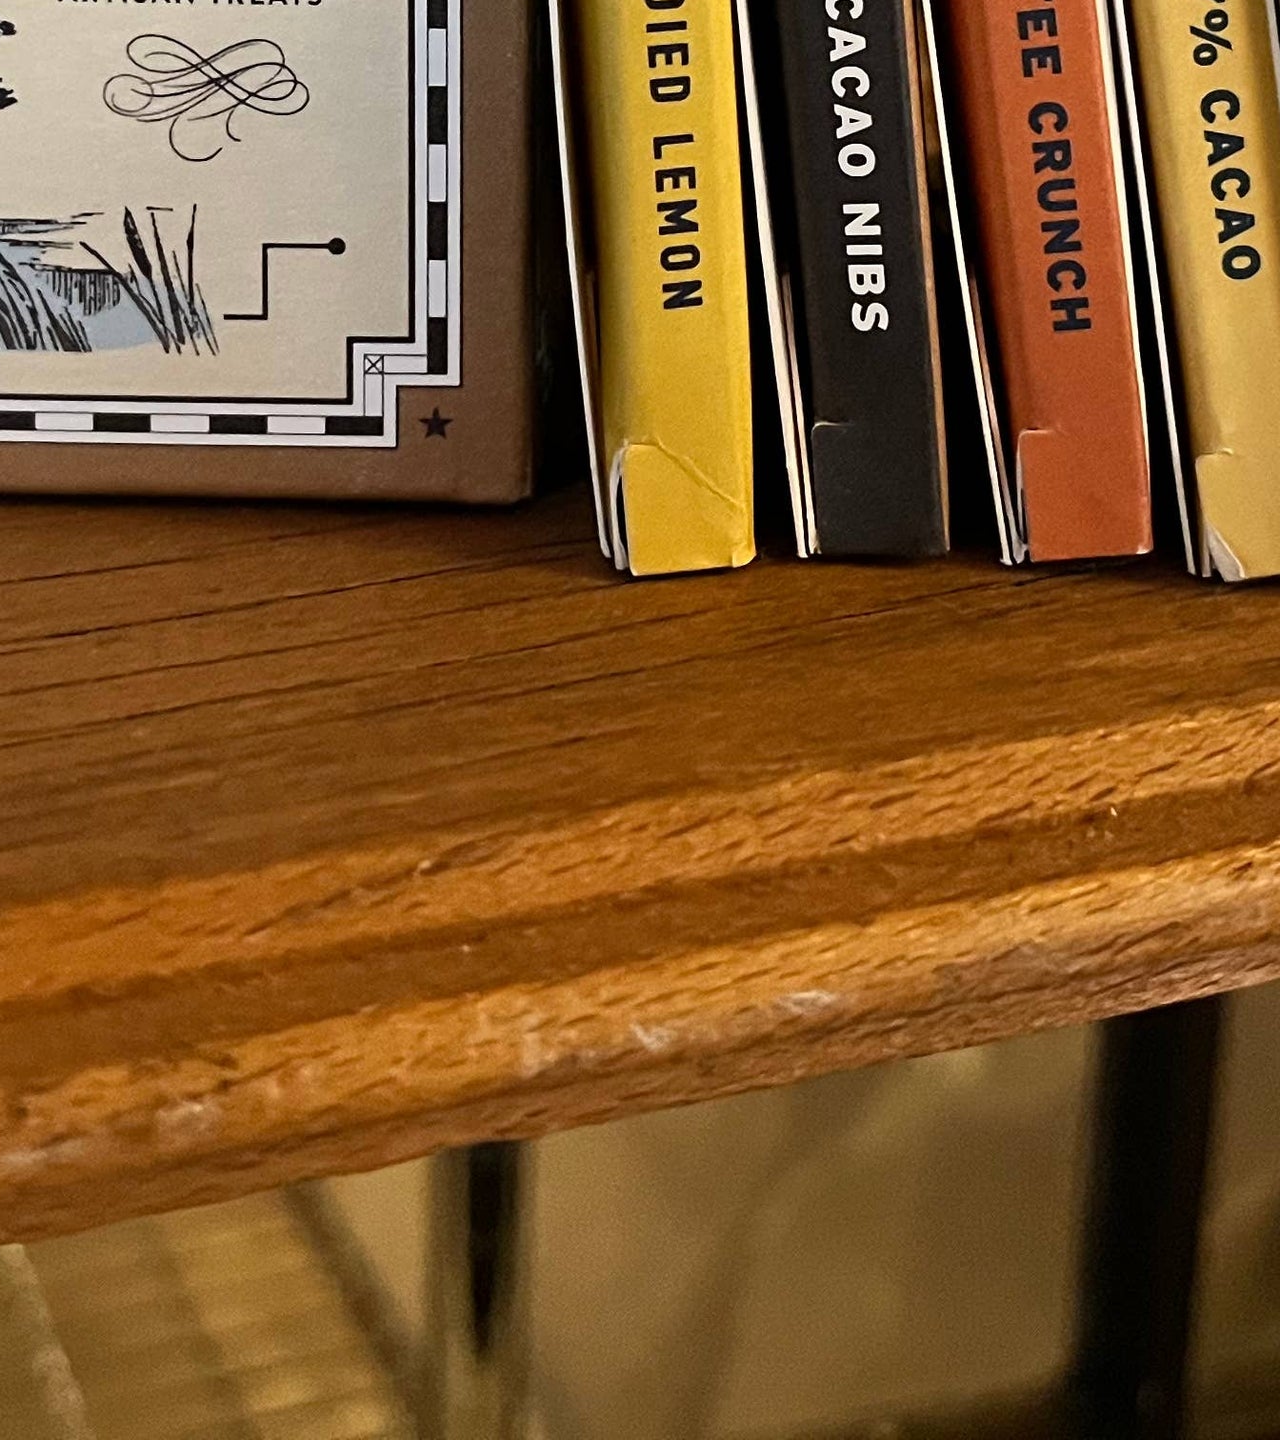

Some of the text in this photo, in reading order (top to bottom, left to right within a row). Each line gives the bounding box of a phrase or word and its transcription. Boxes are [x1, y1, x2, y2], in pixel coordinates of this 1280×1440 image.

[653, 133, 703, 311] LEMON
[842, 202, 889, 333] NIBS
[1027, 101, 1092, 334] CRUNCH
[1200, 89, 1261, 280] CACAO
